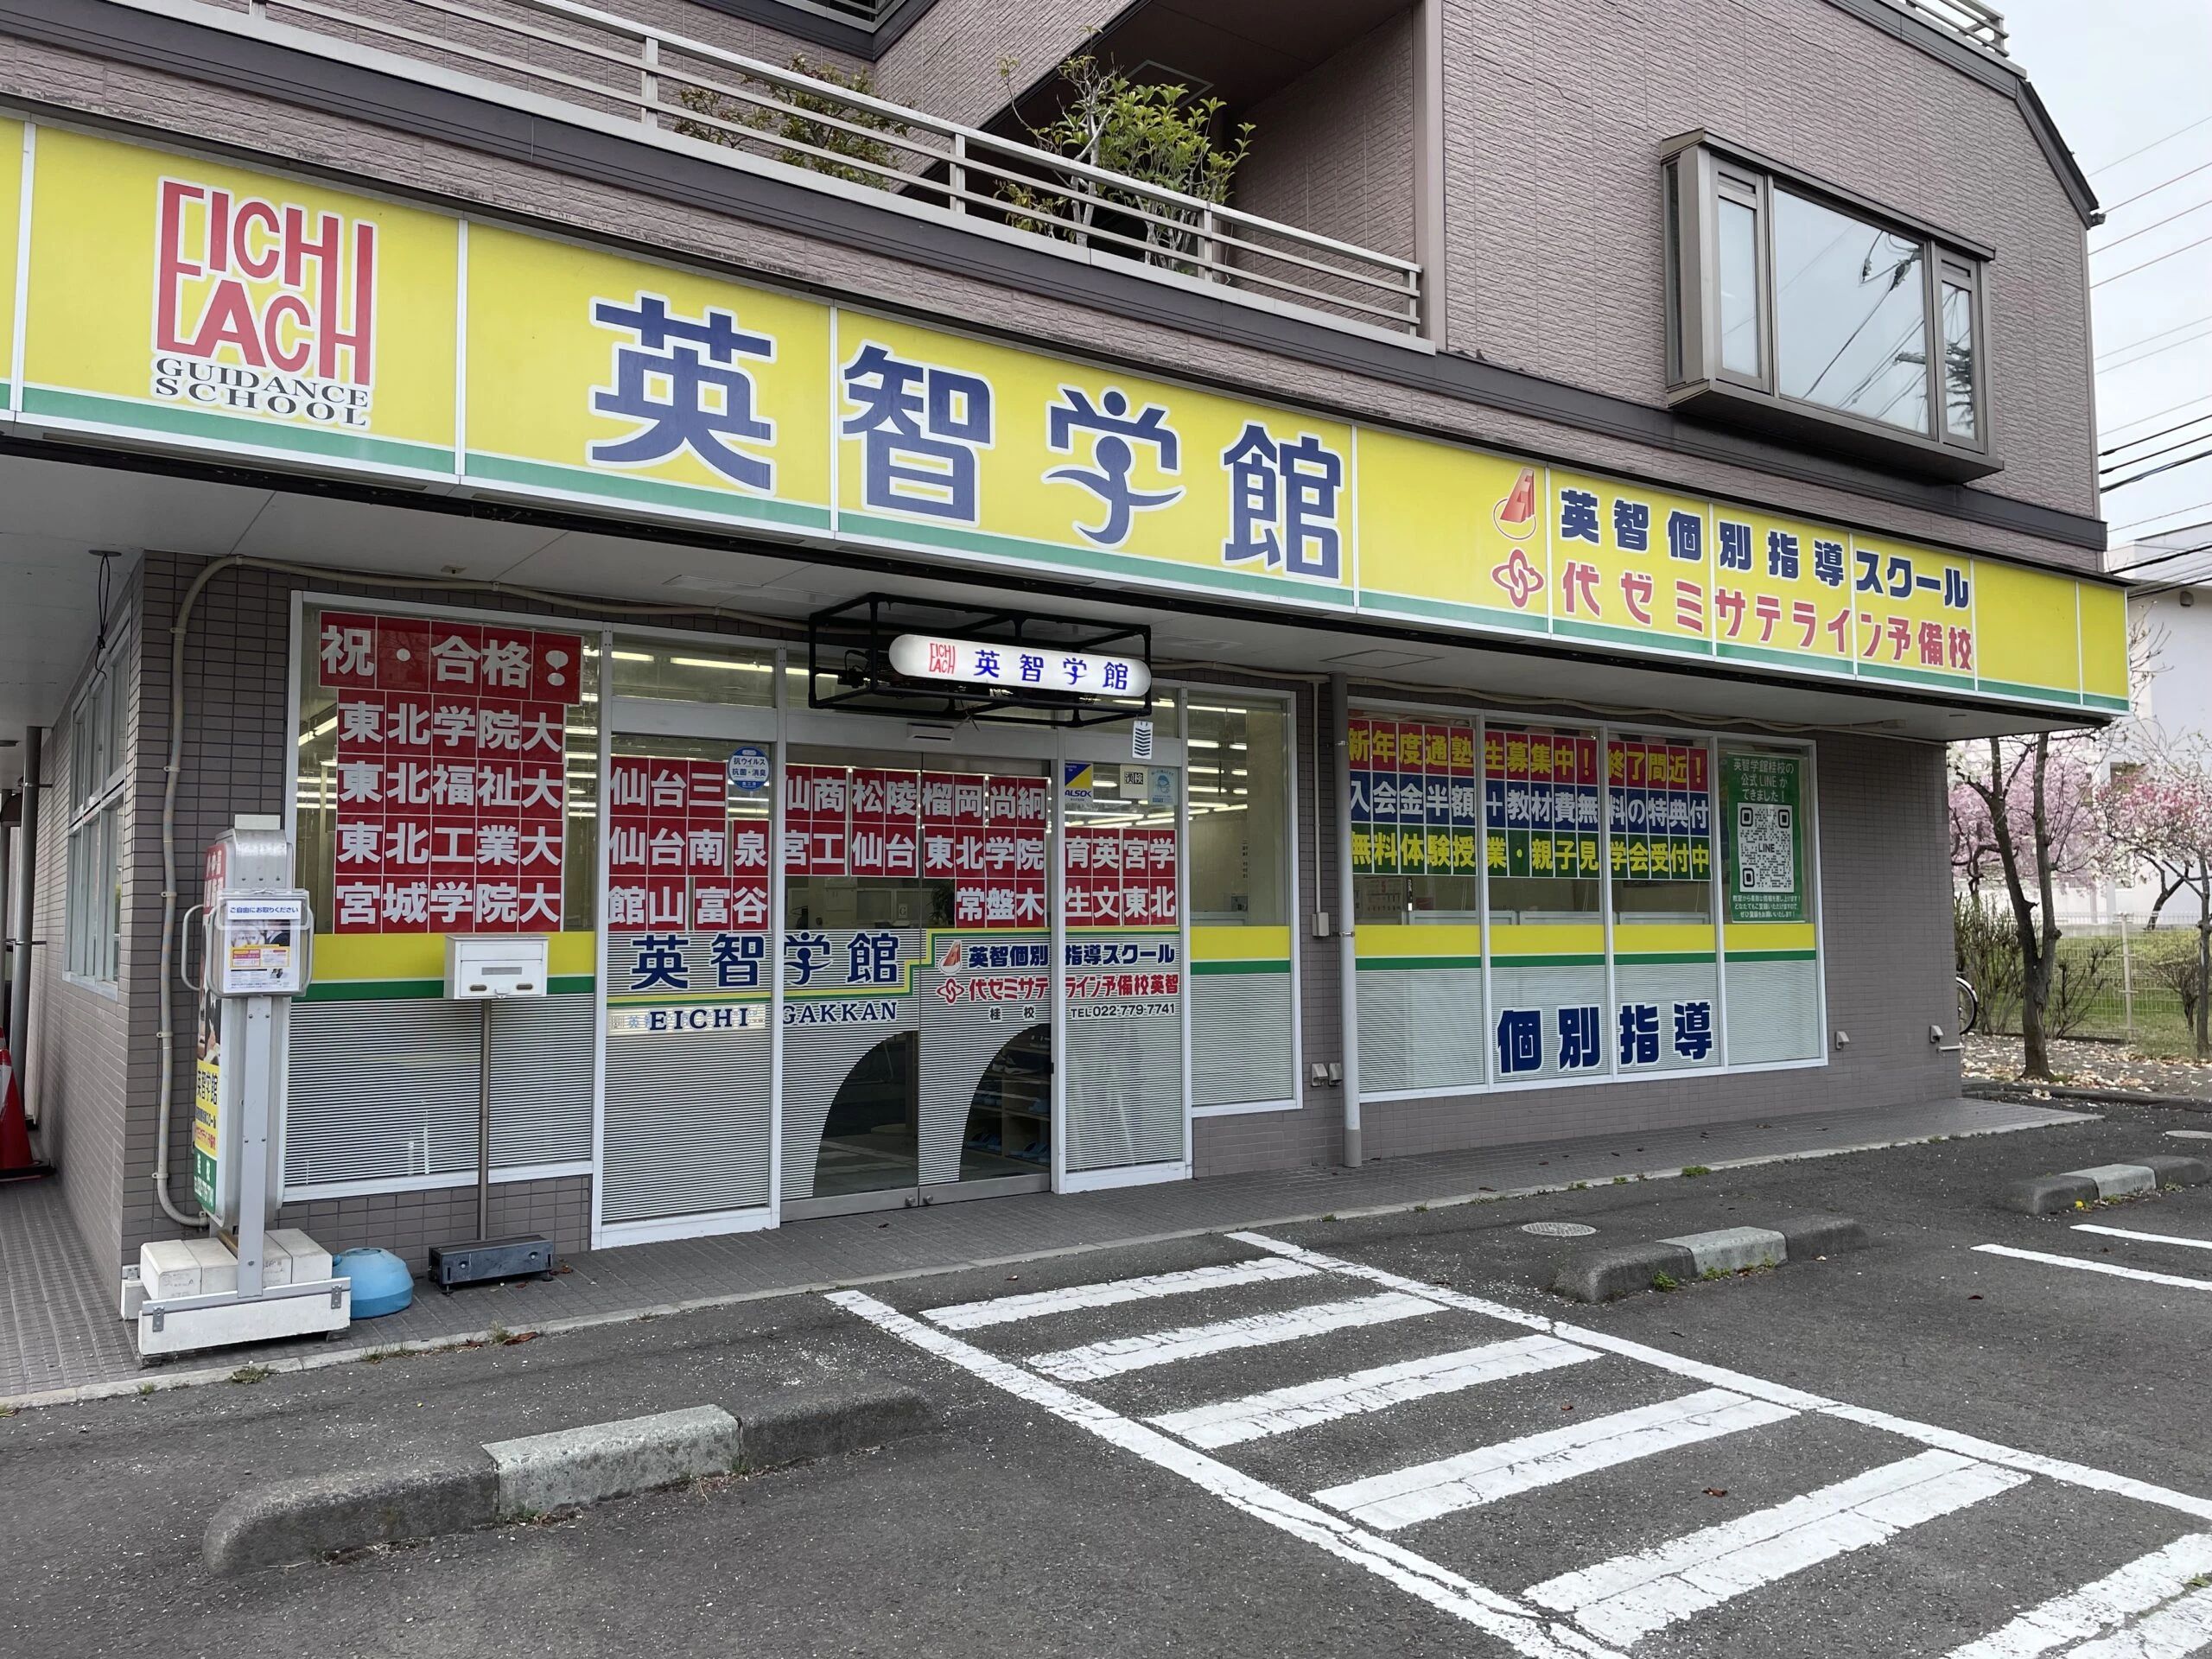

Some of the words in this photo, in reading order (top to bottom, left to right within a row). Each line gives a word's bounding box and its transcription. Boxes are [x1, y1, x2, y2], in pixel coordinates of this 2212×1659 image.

[156, 357, 368, 409] GUIDANCE
[156, 377, 367, 427] SCHOOL
[591, 296, 1343, 579] 英智学館
[1560, 489, 1968, 607] 英智個別指導スクール
[1562, 562, 1974, 671] 代ゼミサテライン予備校
[973, 649, 1128, 690] 英智学館
[339, 701, 563, 753] 東北学院大
[338, 761, 563, 810] 東北福祉大
[610, 767, 725, 808] 仙台三
[338, 821, 562, 867] 東北工業大
[610, 827, 725, 867] 仙台南
[925, 835, 1044, 871] 東北学院
[1758, 843, 1775, 853] LINE
[335, 882, 561, 925] 宮城学院大
[695, 887, 767, 925] 富谷
[957, 887, 1044, 922] 常盤木
[630, 931, 899, 990] 英智学館
[969, 944, 1175, 969] 英智個別指導スクール
[649, 1007, 749, 1031] EICHI
[783, 1001, 897, 1024] GAKKAN
[1497, 1001, 1713, 1074] 個別指導
